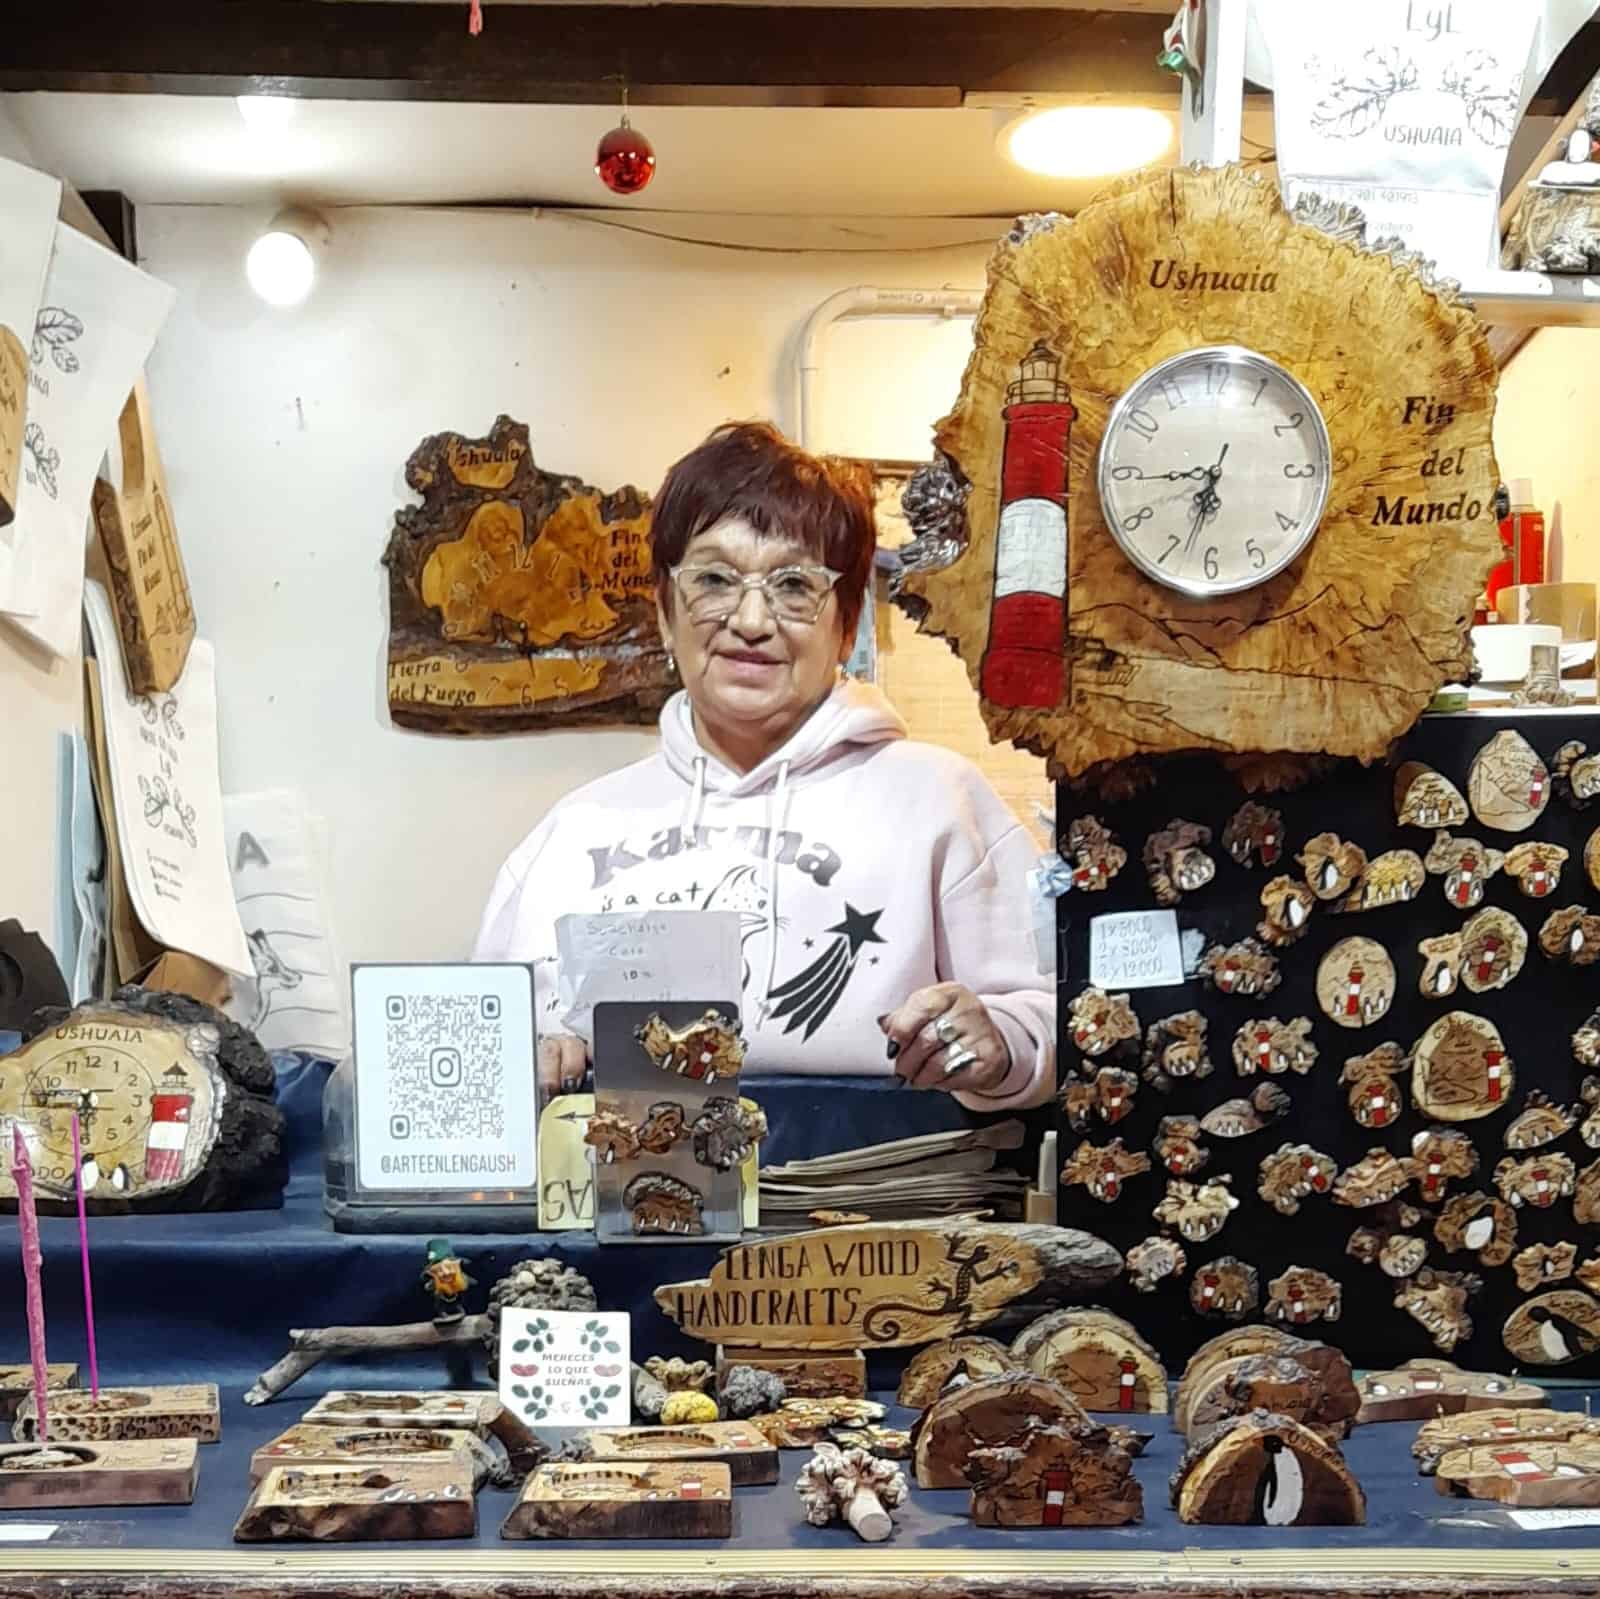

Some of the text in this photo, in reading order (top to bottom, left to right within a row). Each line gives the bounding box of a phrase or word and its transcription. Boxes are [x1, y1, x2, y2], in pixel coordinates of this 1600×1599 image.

[1384, 126, 1462, 146] USHUAIA
[1150, 259, 1279, 293] Ushuaia
[1204, 362, 1231, 396] 12
[1251, 377, 1269, 407] 1
[1402, 396, 1456, 425] Fin
[1124, 409, 1159, 443] 10
[1274, 413, 1303, 437] 2
[1284, 464, 1316, 479] 3
[1421, 448, 1465, 477] del
[1370, 491, 1482, 526] Mundo
[1122, 507, 1154, 532] 8
[1275, 511, 1300, 532] 4
[613, 551, 637, 568] del
[1158, 535, 1181, 565] 7
[1245, 538, 1266, 569] 5
[1204, 546, 1219, 580] 6
[389, 660, 442, 680] Tierra
[390, 683, 477, 710] del Fuego
[602, 881, 703, 912] is a cat
[55, 1026, 144, 1044] USHUAIA
[65, 1060, 79, 1075] 11
[83, 1055, 102, 1069] 12
[113, 1059, 120, 1074] 1
[45, 1075, 62, 1089] 10
[127, 1073, 139, 1086] 2
[131, 1094, 143, 1108] 3
[122, 1114, 134, 1127] 4
[54, 1127, 68, 1142] 7
[106, 1128, 118, 1141] 5
[381, 1154, 517, 1174] @ARTEENLENGAUSH
[725, 1239, 920, 1280] LENGA WOOD
[676, 1287, 863, 1329] HANDCRAFTS
[548, 1366, 590, 1376] LO QUE
